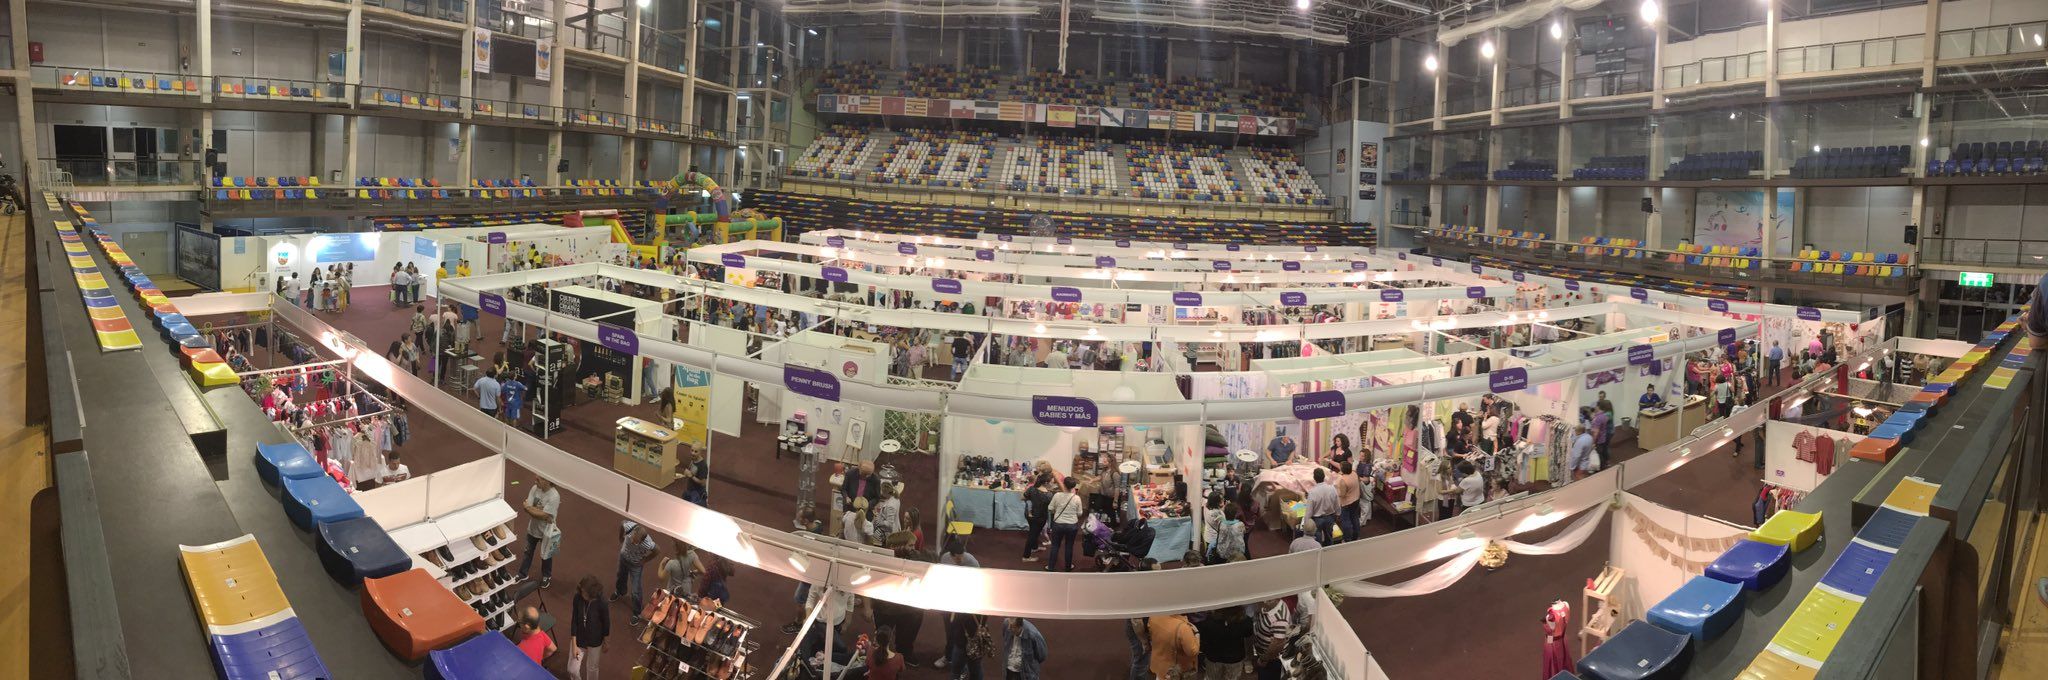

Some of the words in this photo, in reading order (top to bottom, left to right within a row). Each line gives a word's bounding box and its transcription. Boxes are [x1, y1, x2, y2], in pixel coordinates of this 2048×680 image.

[790, 376, 811, 385] PENNY
[812, 380, 833, 390] BRUSH
[1046, 405, 1084, 413] MENUDOS
[1295, 402, 1331, 412] CORTYGAR
[1074, 412, 1092, 420] MÁS
[1486, 459, 1491, 468] 3
